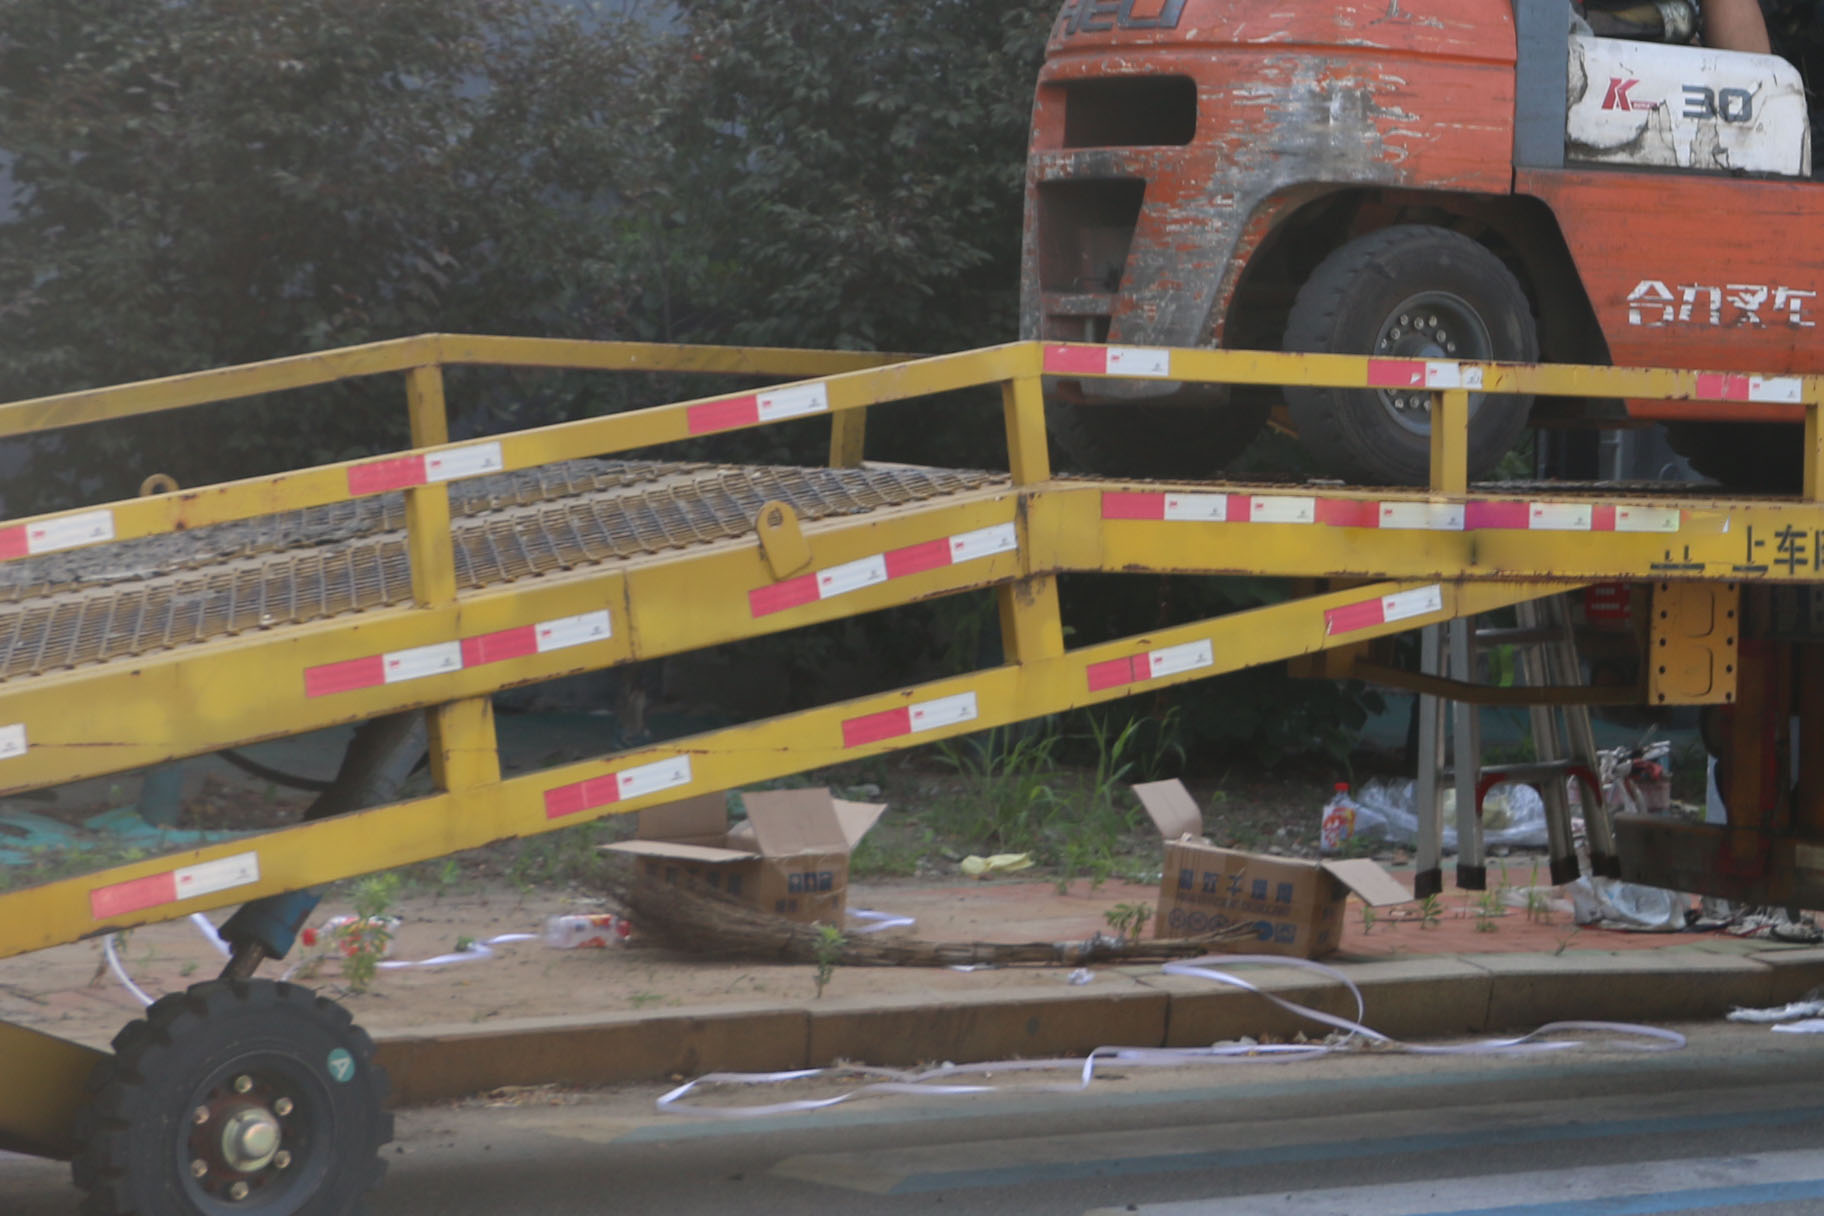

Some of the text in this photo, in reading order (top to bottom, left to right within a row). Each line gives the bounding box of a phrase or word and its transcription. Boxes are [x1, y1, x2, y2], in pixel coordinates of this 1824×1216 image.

[1681, 83, 1753, 123] 30
[1626, 279, 1817, 329] 合力叉车
